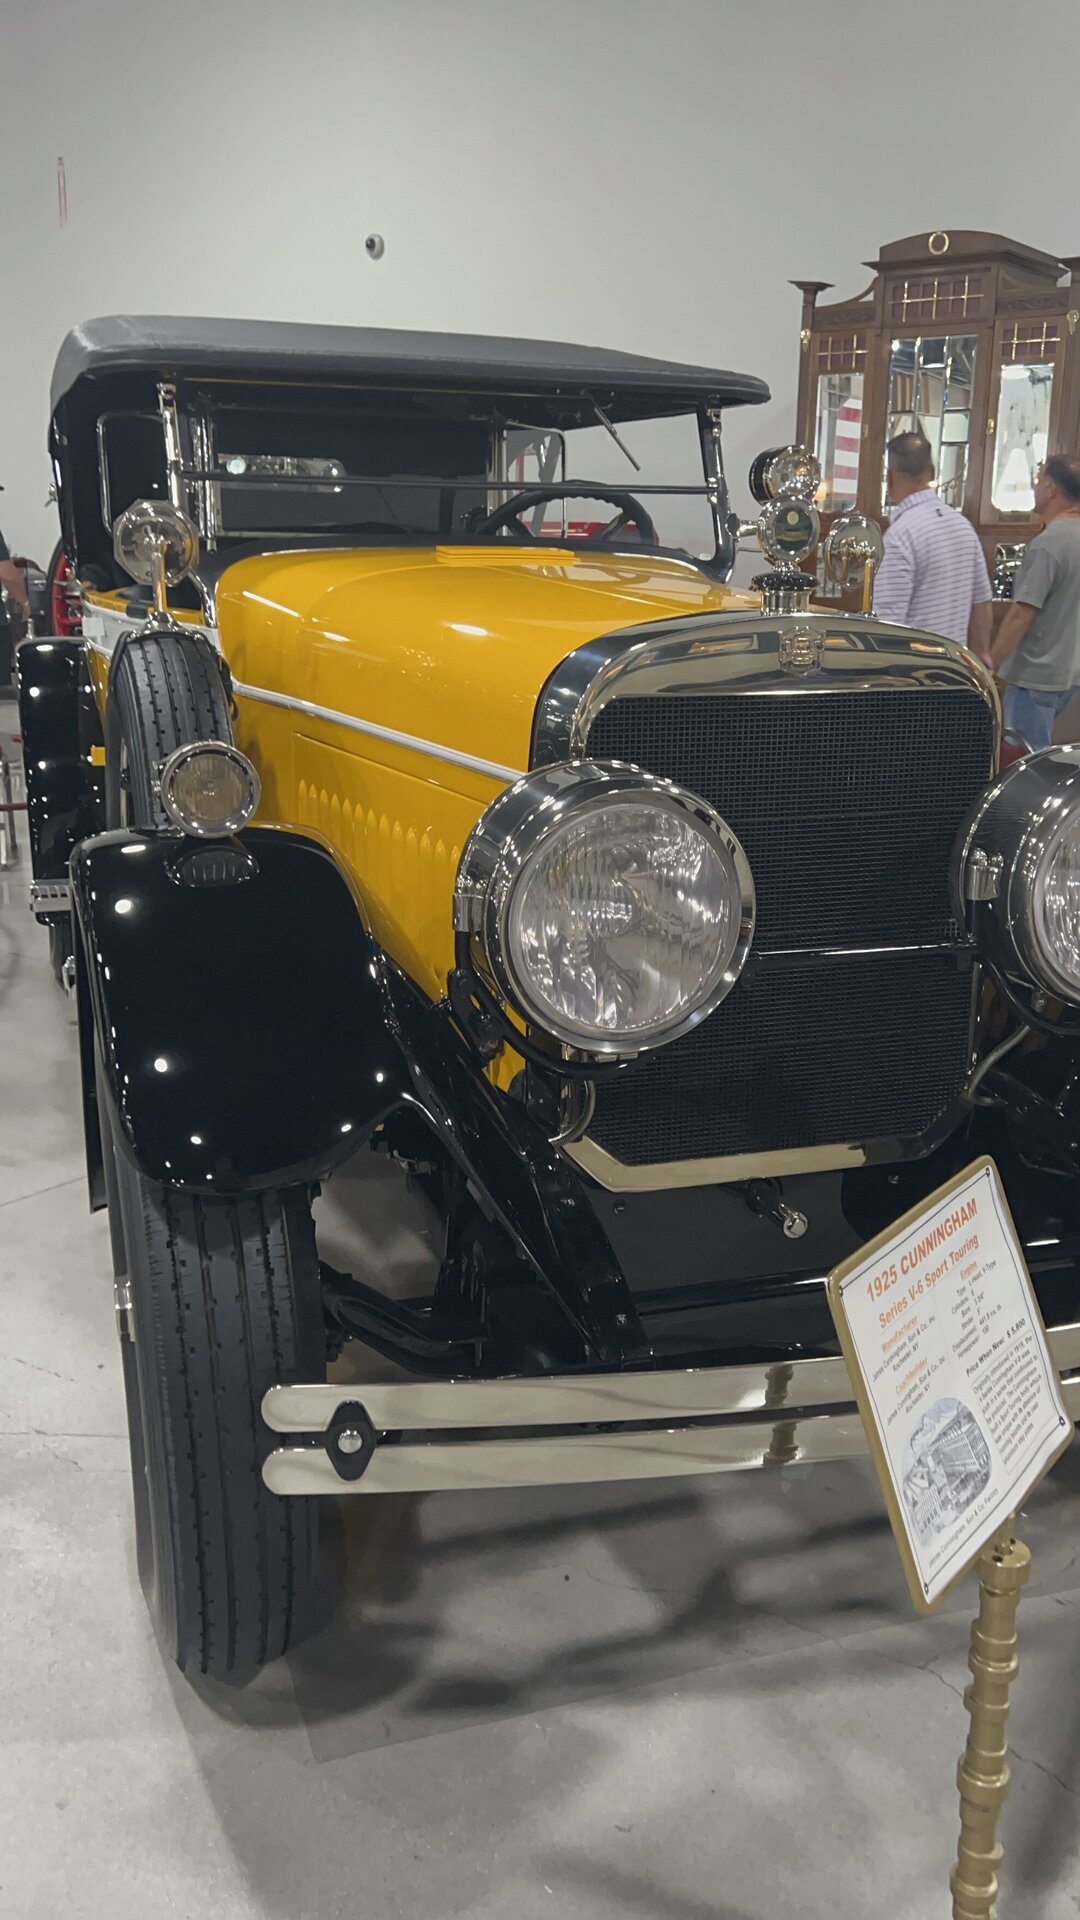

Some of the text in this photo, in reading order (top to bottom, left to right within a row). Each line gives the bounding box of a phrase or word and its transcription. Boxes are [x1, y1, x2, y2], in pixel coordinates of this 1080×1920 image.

[867, 1198, 977, 1302] 1925 CUNNINGHAM
[879, 1234, 979, 1329] Series V-6 Sport Touring
[881, 1315, 918, 1353] Manufacturer
[966, 1362, 979, 1377] Price
[978, 1349, 992, 1364] When
